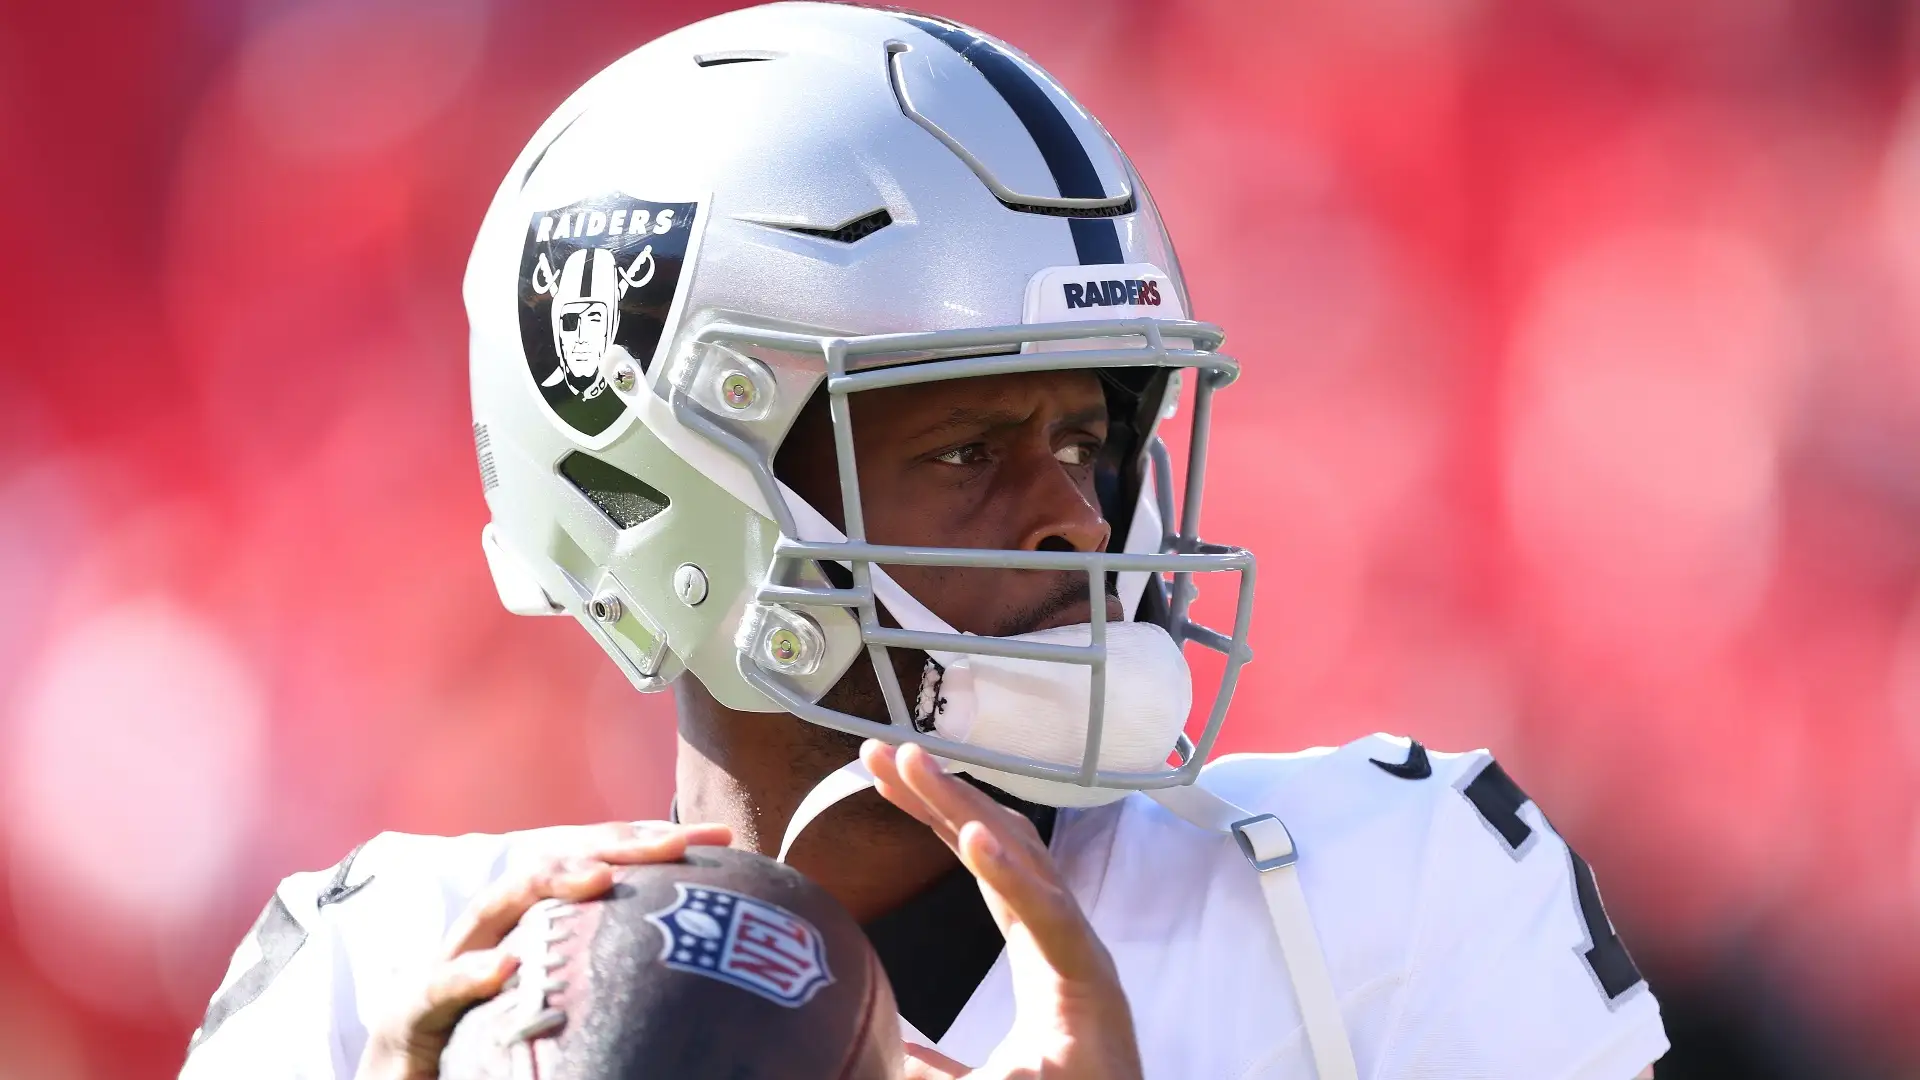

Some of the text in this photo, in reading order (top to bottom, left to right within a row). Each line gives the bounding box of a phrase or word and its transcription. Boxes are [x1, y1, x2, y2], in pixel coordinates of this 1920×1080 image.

[535, 208, 675, 243] RAIDERS
[1063, 279, 1162, 309] RAIDERS
[728, 910, 812, 992] NFL
